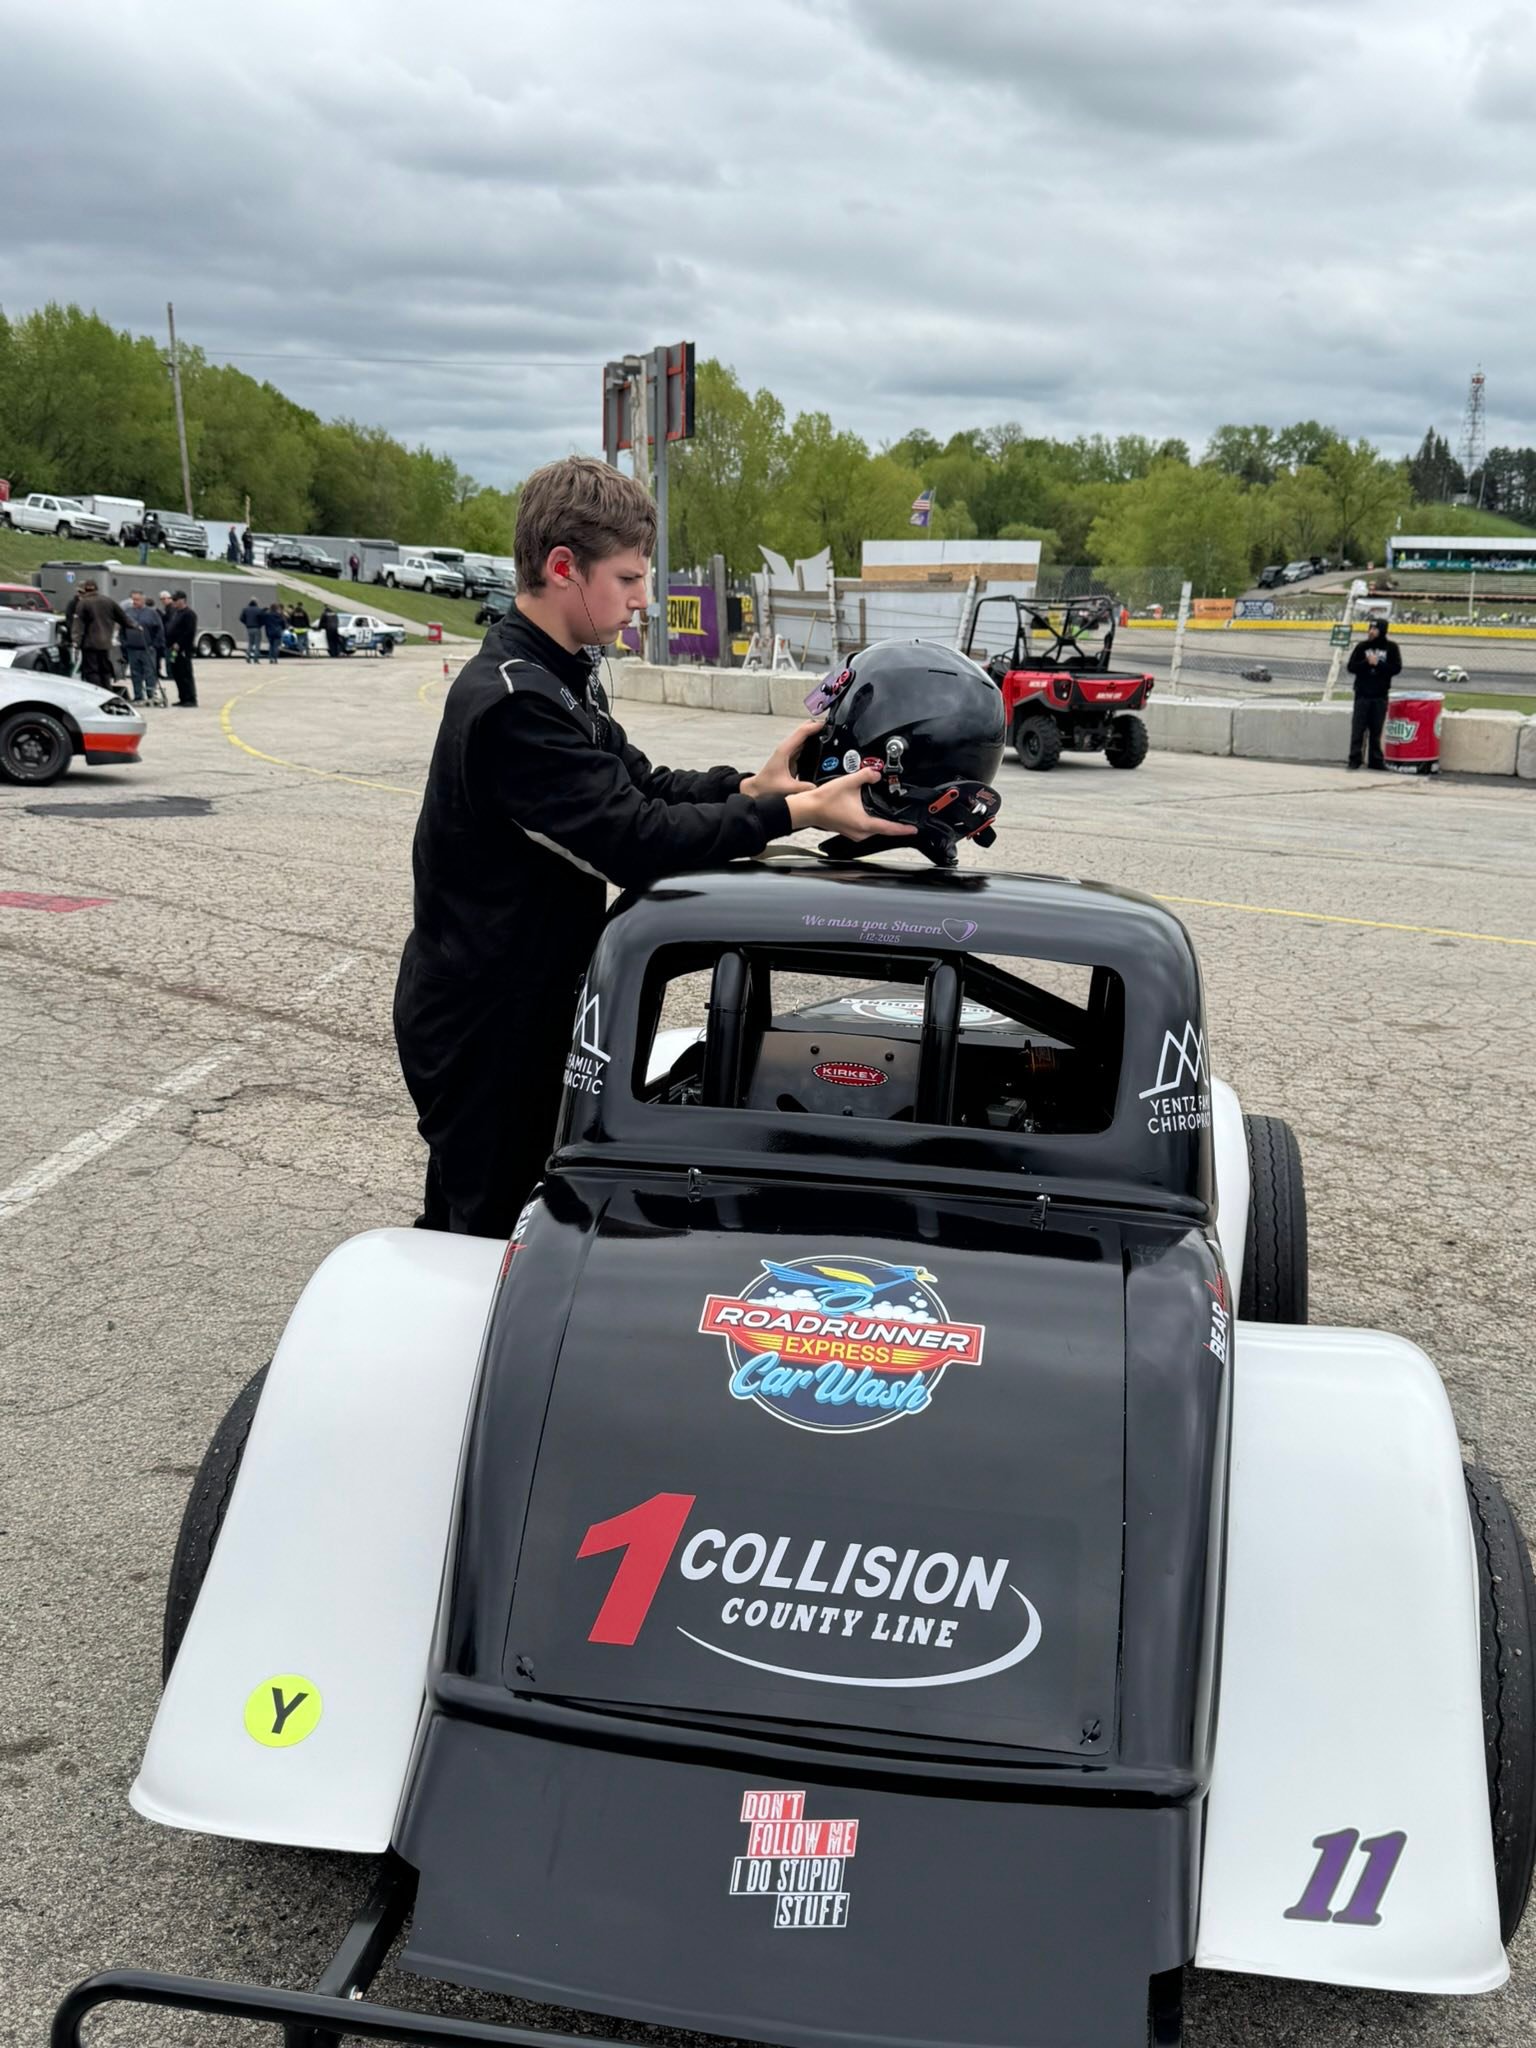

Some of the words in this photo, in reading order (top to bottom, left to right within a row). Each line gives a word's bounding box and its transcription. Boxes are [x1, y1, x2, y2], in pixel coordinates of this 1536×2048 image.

[802, 915, 825, 926] We
[827, 917, 859, 928] miss
[861, 921, 888, 934] you
[891, 920, 943, 935] Sharon
[859, 932, 901, 943] 1-12-2025
[822, 1067, 878, 1080] KIRKEY
[1150, 1095, 1196, 1115] YENTZ
[714, 1306, 972, 1352] ROADRUNNER
[785, 1337, 890, 1363] EXPRESS
[731, 1351, 814, 1398] Car
[814, 1360, 931, 1412] Wash
[576, 1492, 697, 1646] 1
[680, 1528, 1010, 1611] COLLISION
[721, 1597, 863, 1637] COUNTY
[871, 1612, 959, 1648] LINE
[271, 1687, 309, 1734] Y
[744, 1793, 802, 1819] DON'T
[751, 1823, 822, 1855] FOLLOW
[827, 1822, 855, 1854] ME
[733, 1860, 742, 1892] I
[746, 1860, 772, 1892] DO
[777, 1859, 840, 1892] STUPID
[1283, 1827, 1408, 1926] 11
[778, 1895, 846, 1926] STUFF
